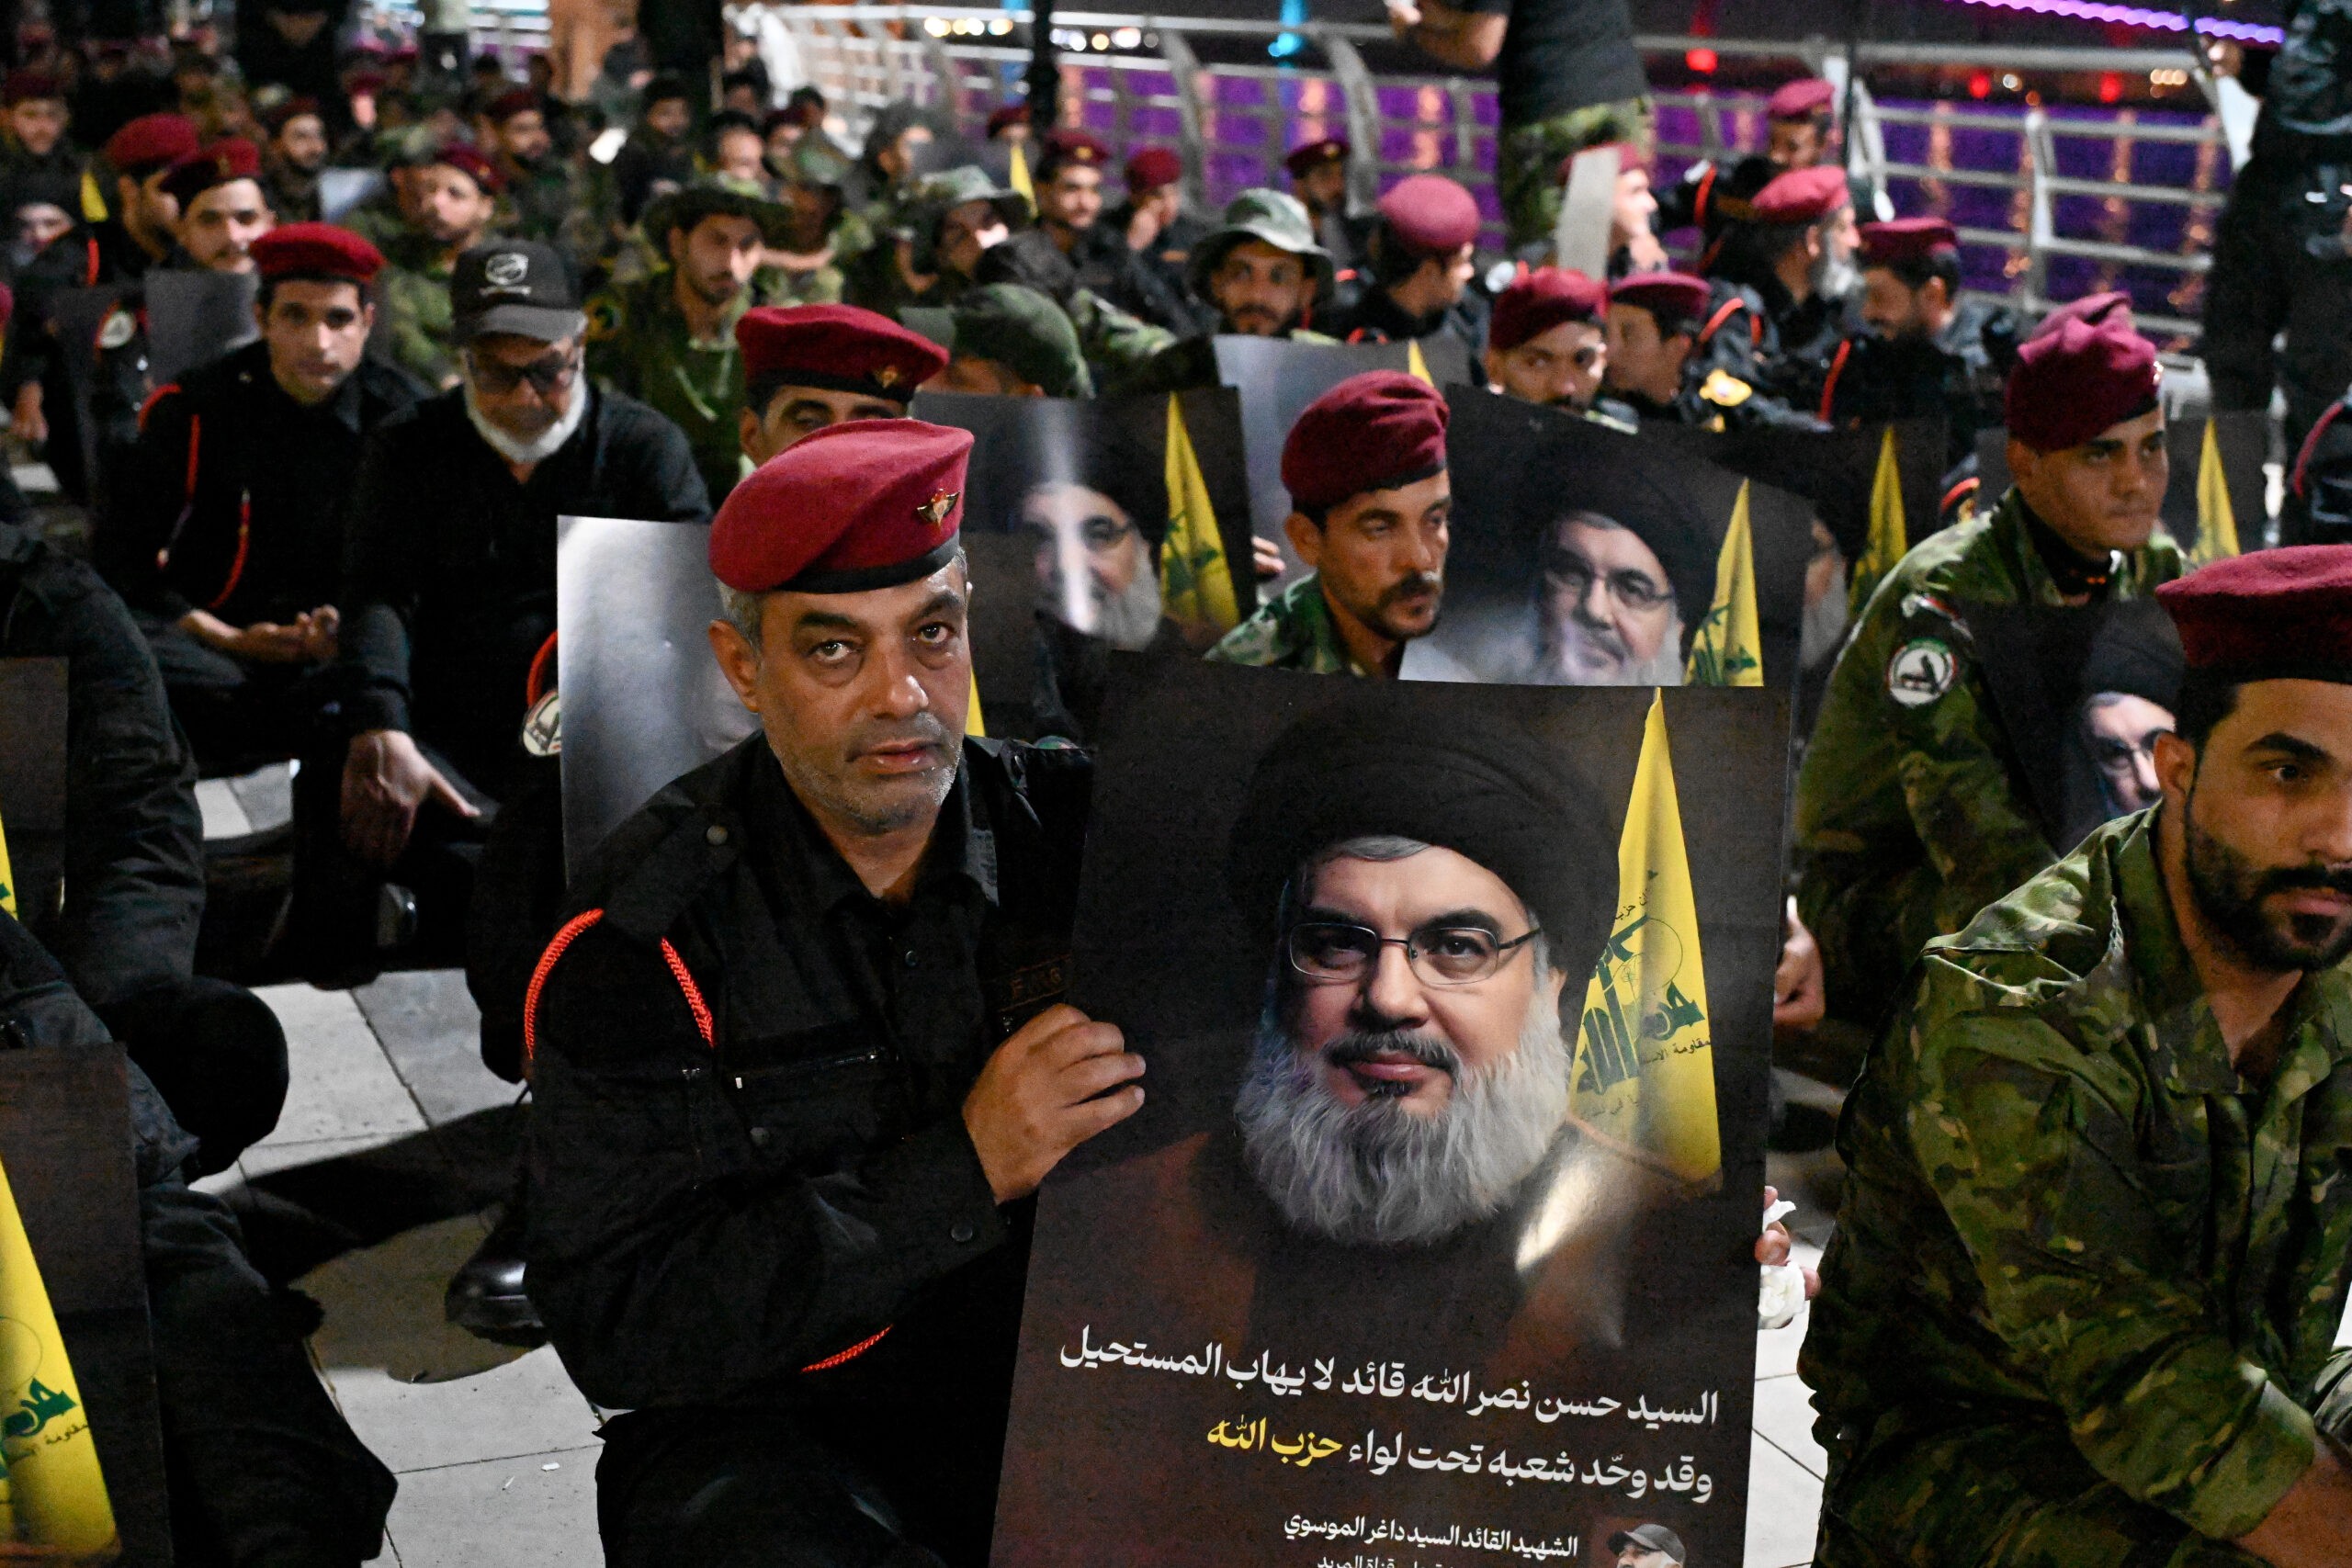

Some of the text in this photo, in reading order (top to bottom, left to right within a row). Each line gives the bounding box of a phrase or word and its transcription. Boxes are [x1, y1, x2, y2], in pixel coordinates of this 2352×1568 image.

[1059, 1324, 1718, 1430] السيد حسن نصر الله قائد لا يهاب المستحيل
[1206, 1415, 1268, 1451] الله
[1271, 1431, 1343, 1468] حزب
[1348, 1429, 1403, 1476] لواء
[1407, 1445, 1485, 1474] تحت
[1487, 1449, 1576, 1487] شعبه
[1653, 1455, 1713, 1504] وقد
[1283, 1514, 1579, 1561] الشهيد القائد السيد داغر الموسوي
